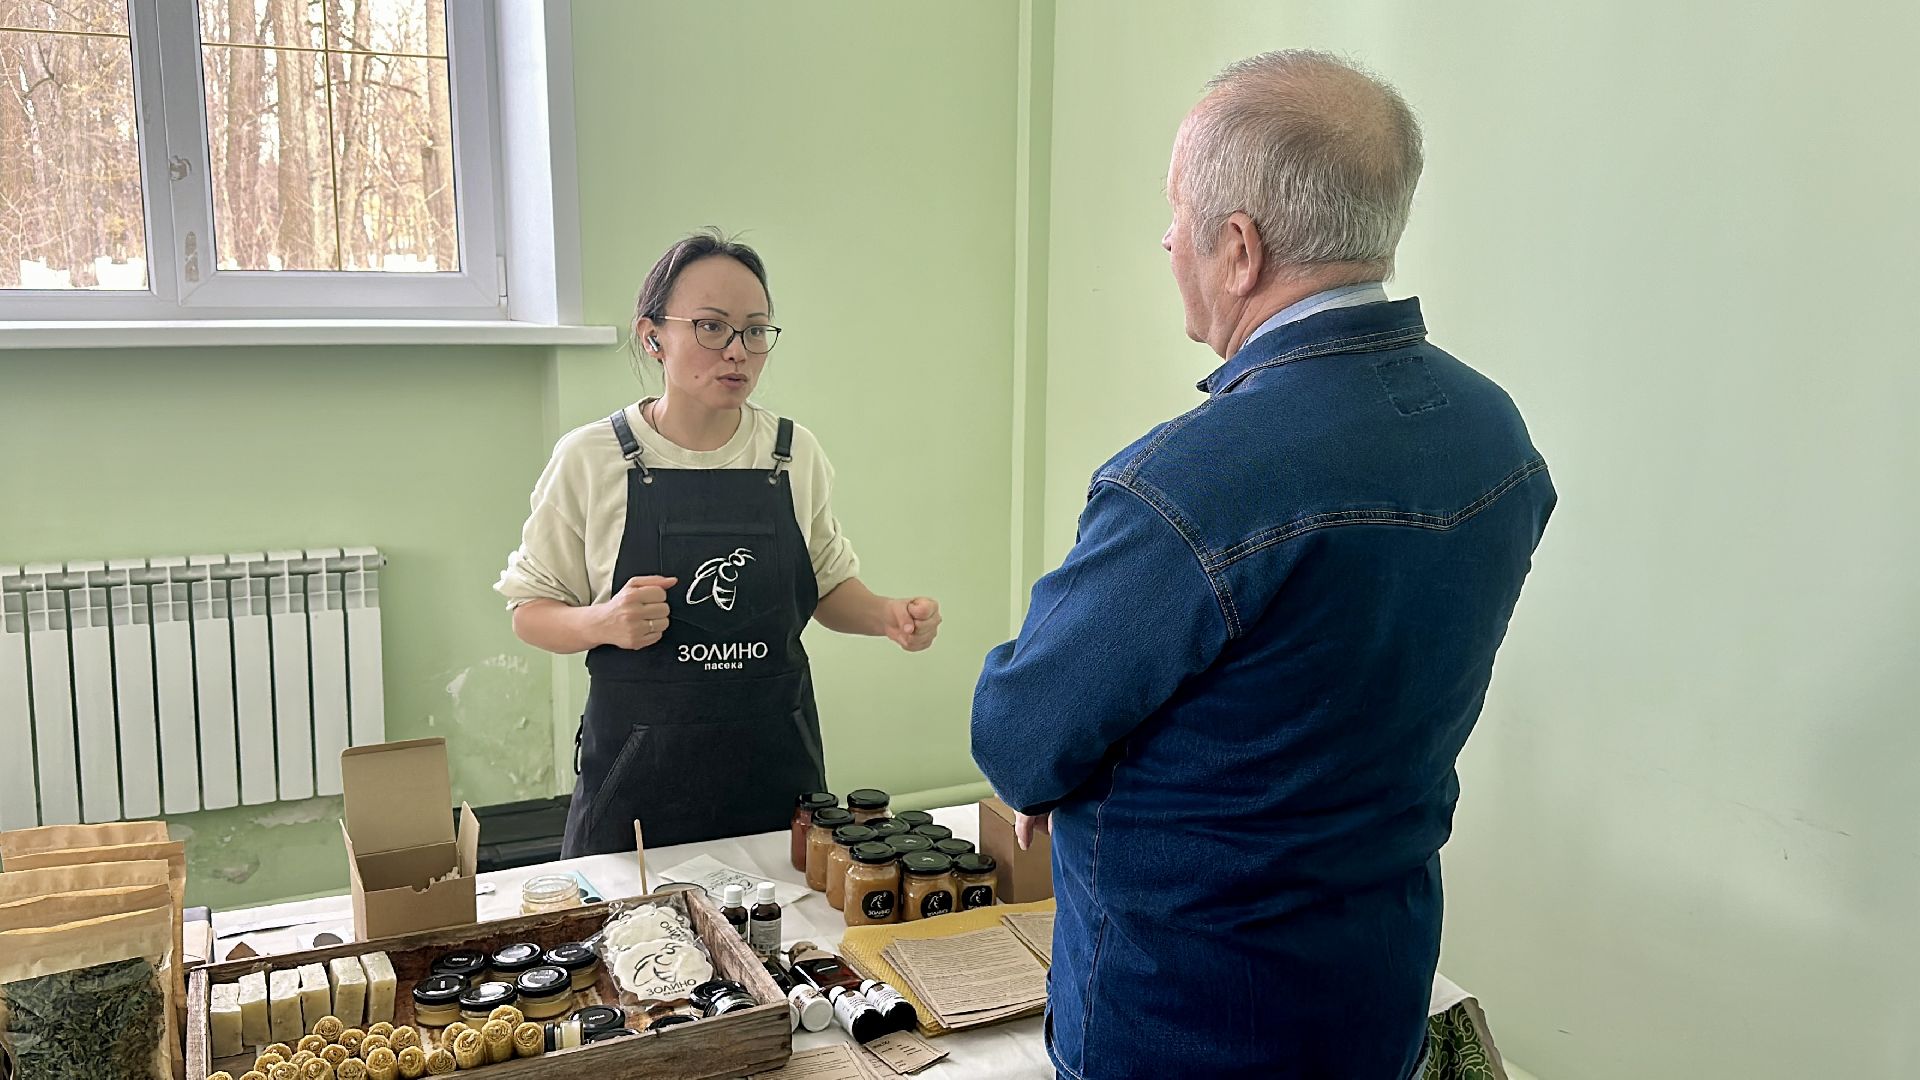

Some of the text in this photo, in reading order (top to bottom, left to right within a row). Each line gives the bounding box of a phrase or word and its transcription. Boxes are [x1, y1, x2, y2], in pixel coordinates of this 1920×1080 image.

[677, 641, 768, 662] ЗОЛИНО
[704, 661, 743, 671] пасека
[645, 978, 697, 996] ЗОЛИНО
